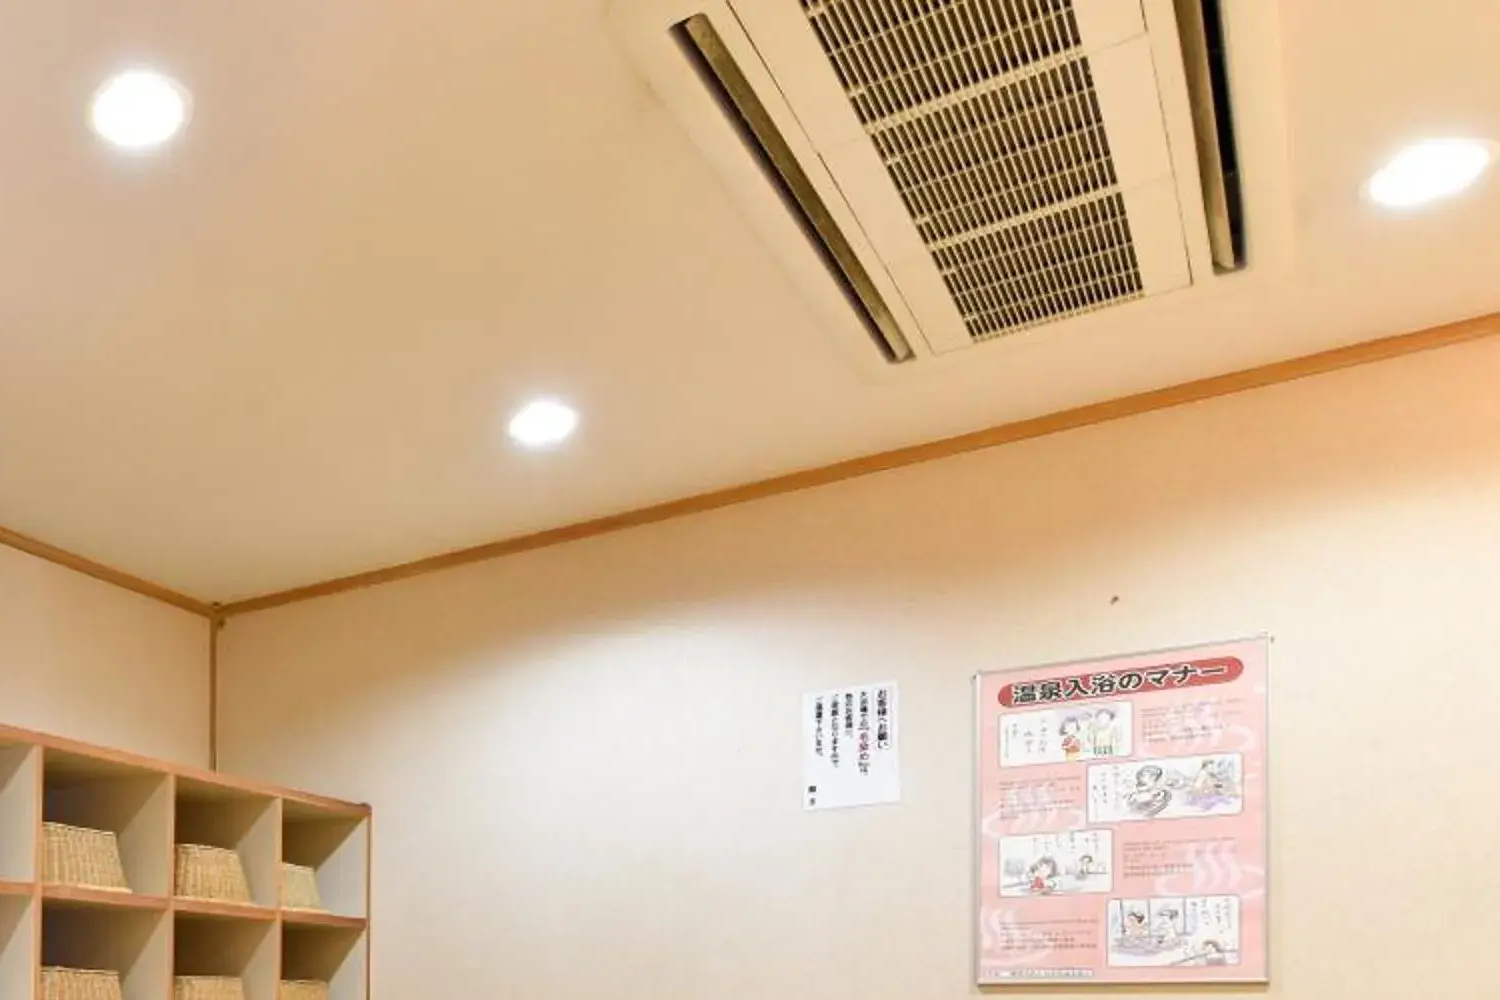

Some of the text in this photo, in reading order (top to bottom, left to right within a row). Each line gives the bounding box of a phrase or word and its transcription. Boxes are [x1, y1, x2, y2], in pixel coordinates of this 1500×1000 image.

[1013, 664, 1227, 703] 温泉入浴のマナー
